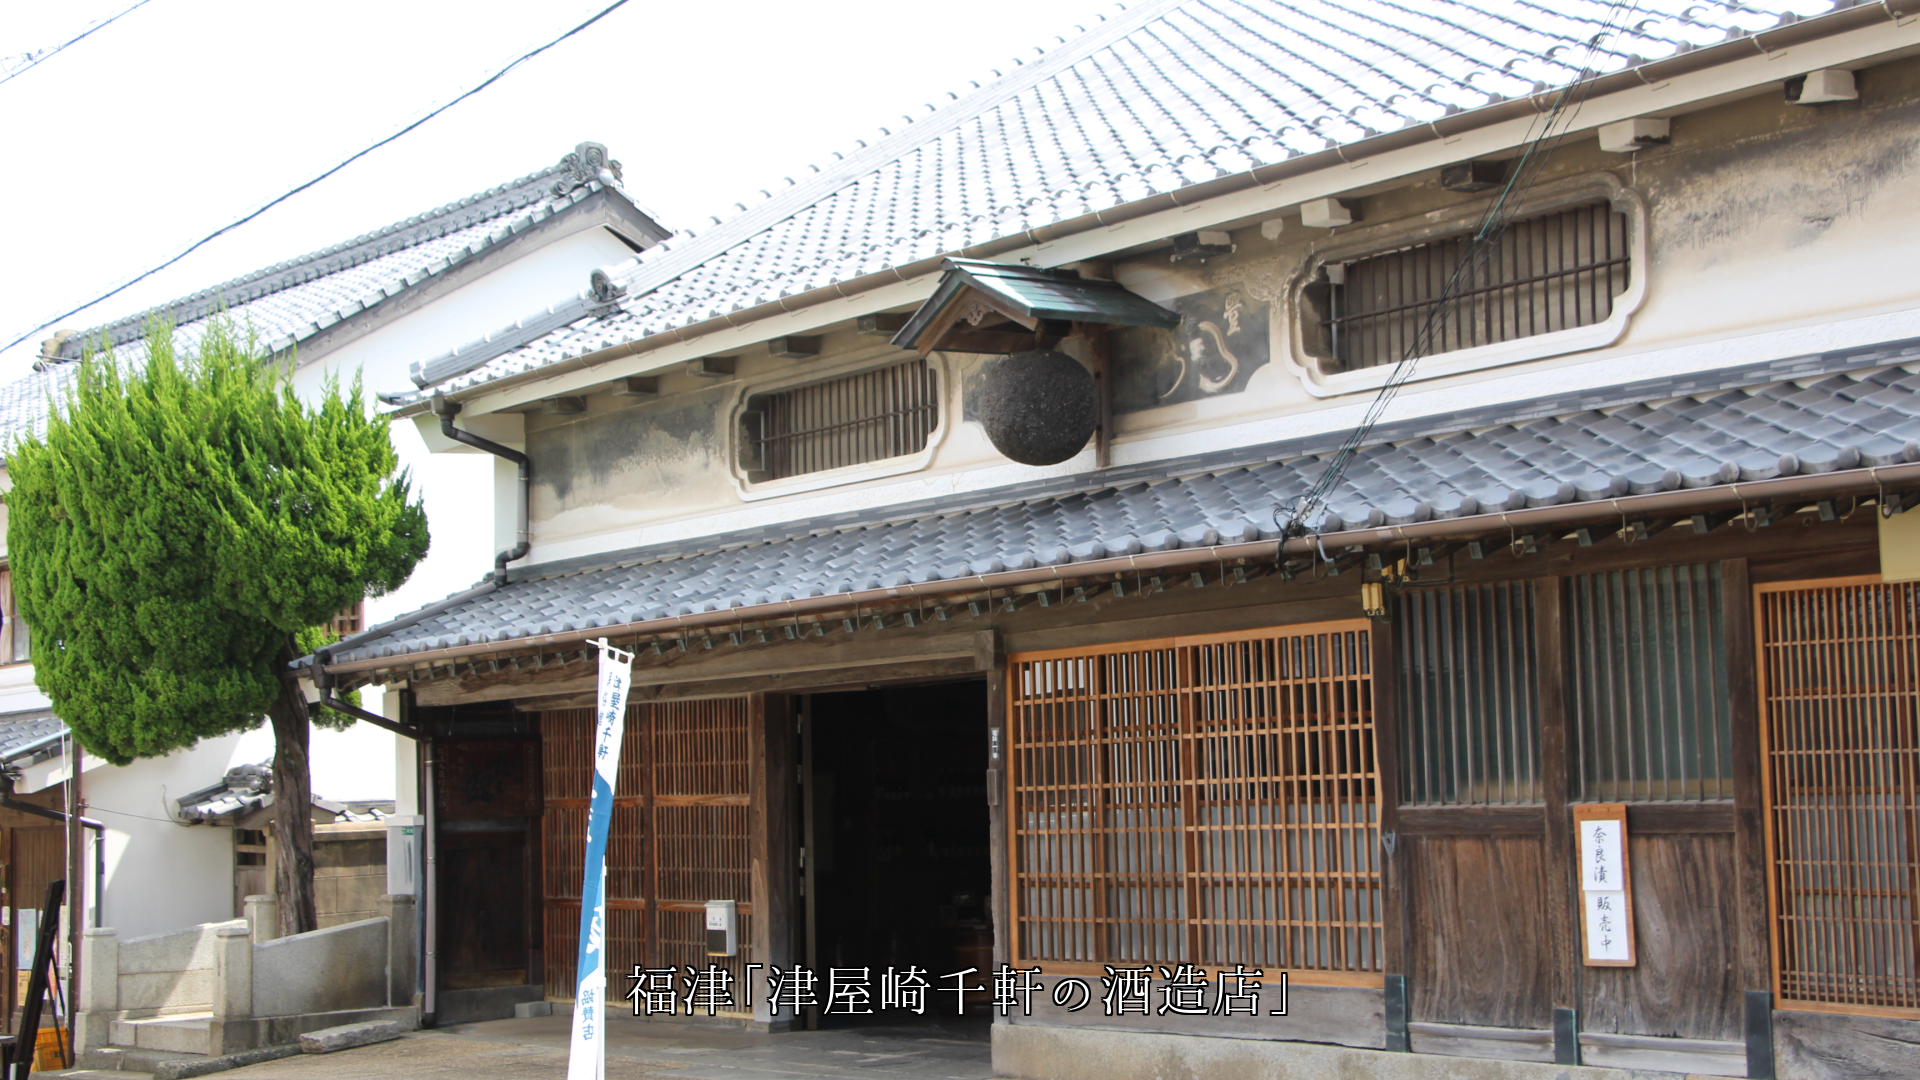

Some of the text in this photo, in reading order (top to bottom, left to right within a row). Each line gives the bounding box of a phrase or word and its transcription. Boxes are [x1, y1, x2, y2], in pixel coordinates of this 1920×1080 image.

[597, 675, 622, 760] 津屋崎千軒
[1592, 825, 1612, 952] 奈良漬 販売中
